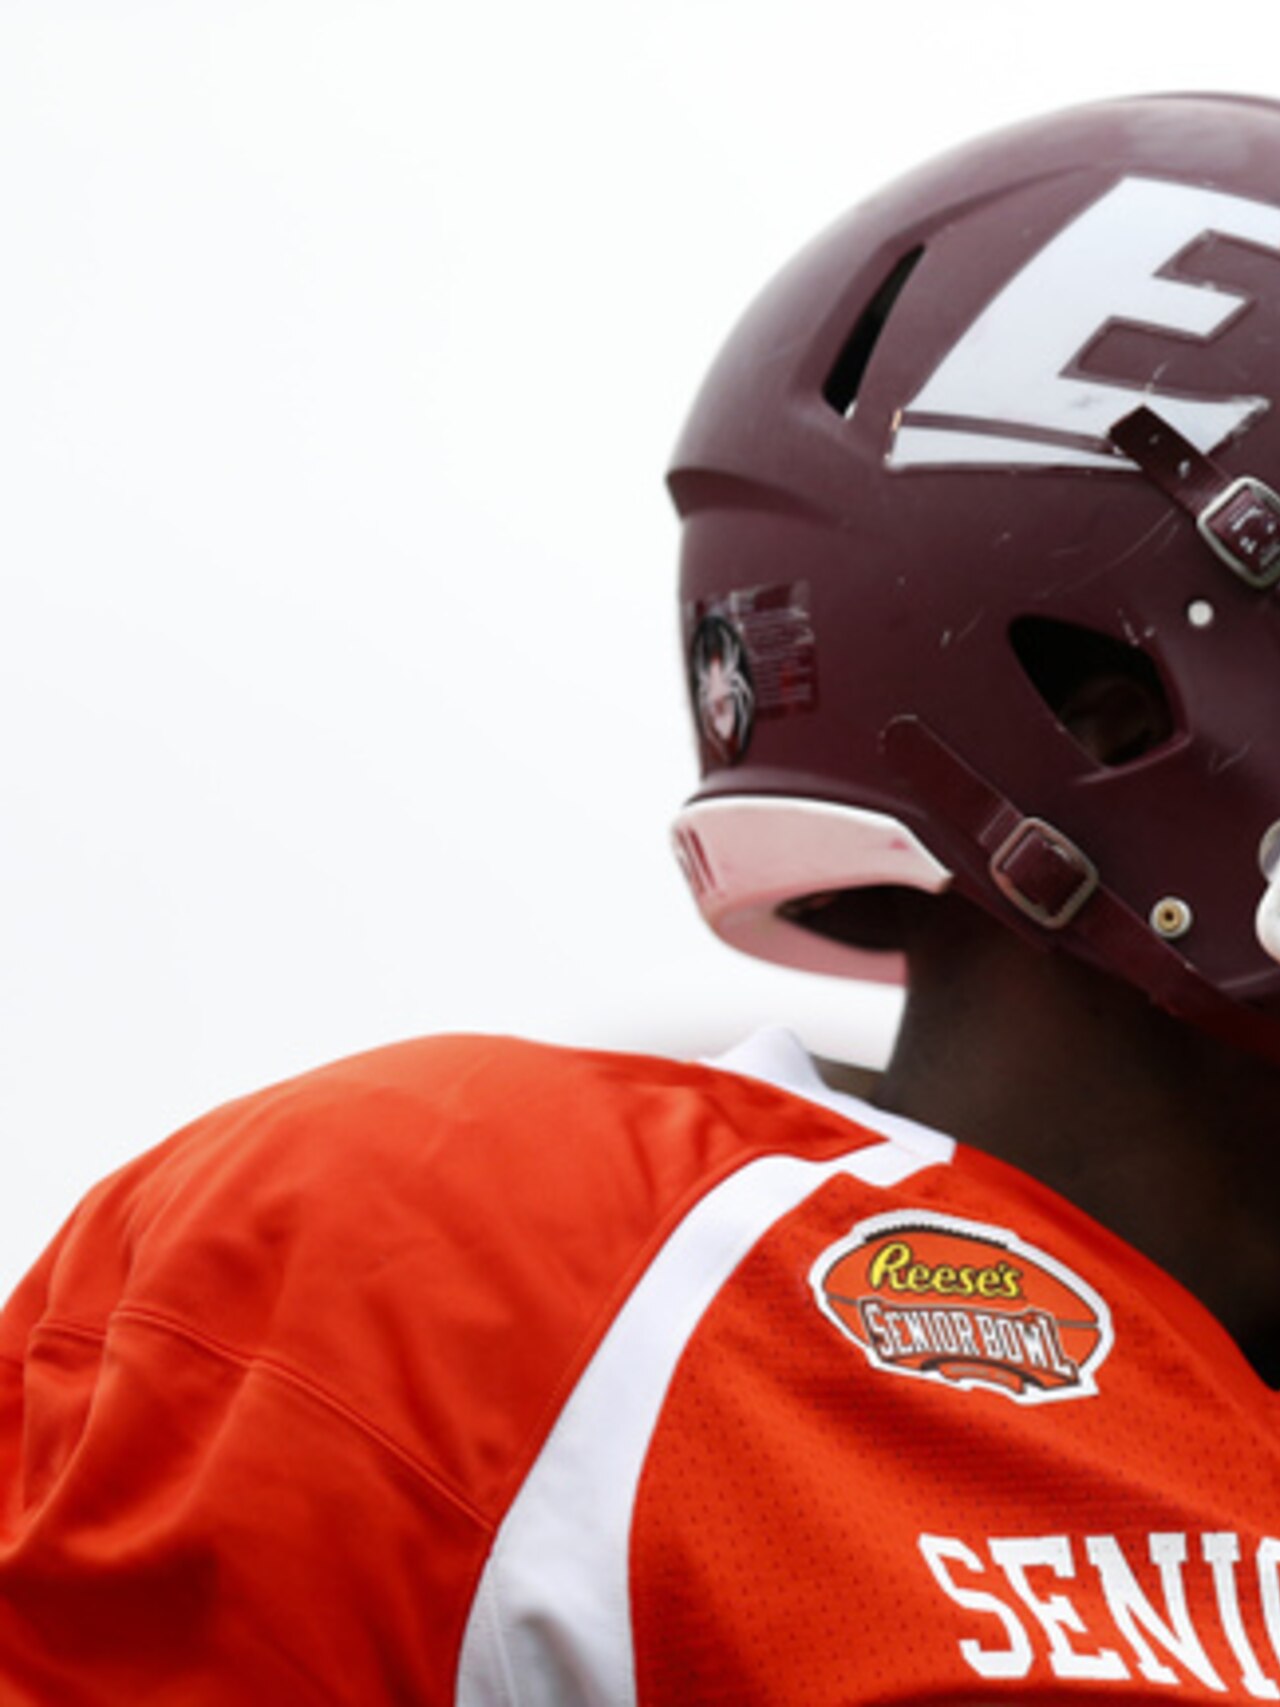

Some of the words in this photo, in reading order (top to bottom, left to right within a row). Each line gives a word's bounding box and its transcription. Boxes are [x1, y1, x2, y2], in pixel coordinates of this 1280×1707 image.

[869, 1243, 1021, 1298] Reese's
[865, 1303, 979, 1358] SENIOR
[976, 1315, 1073, 1377] BOWL
